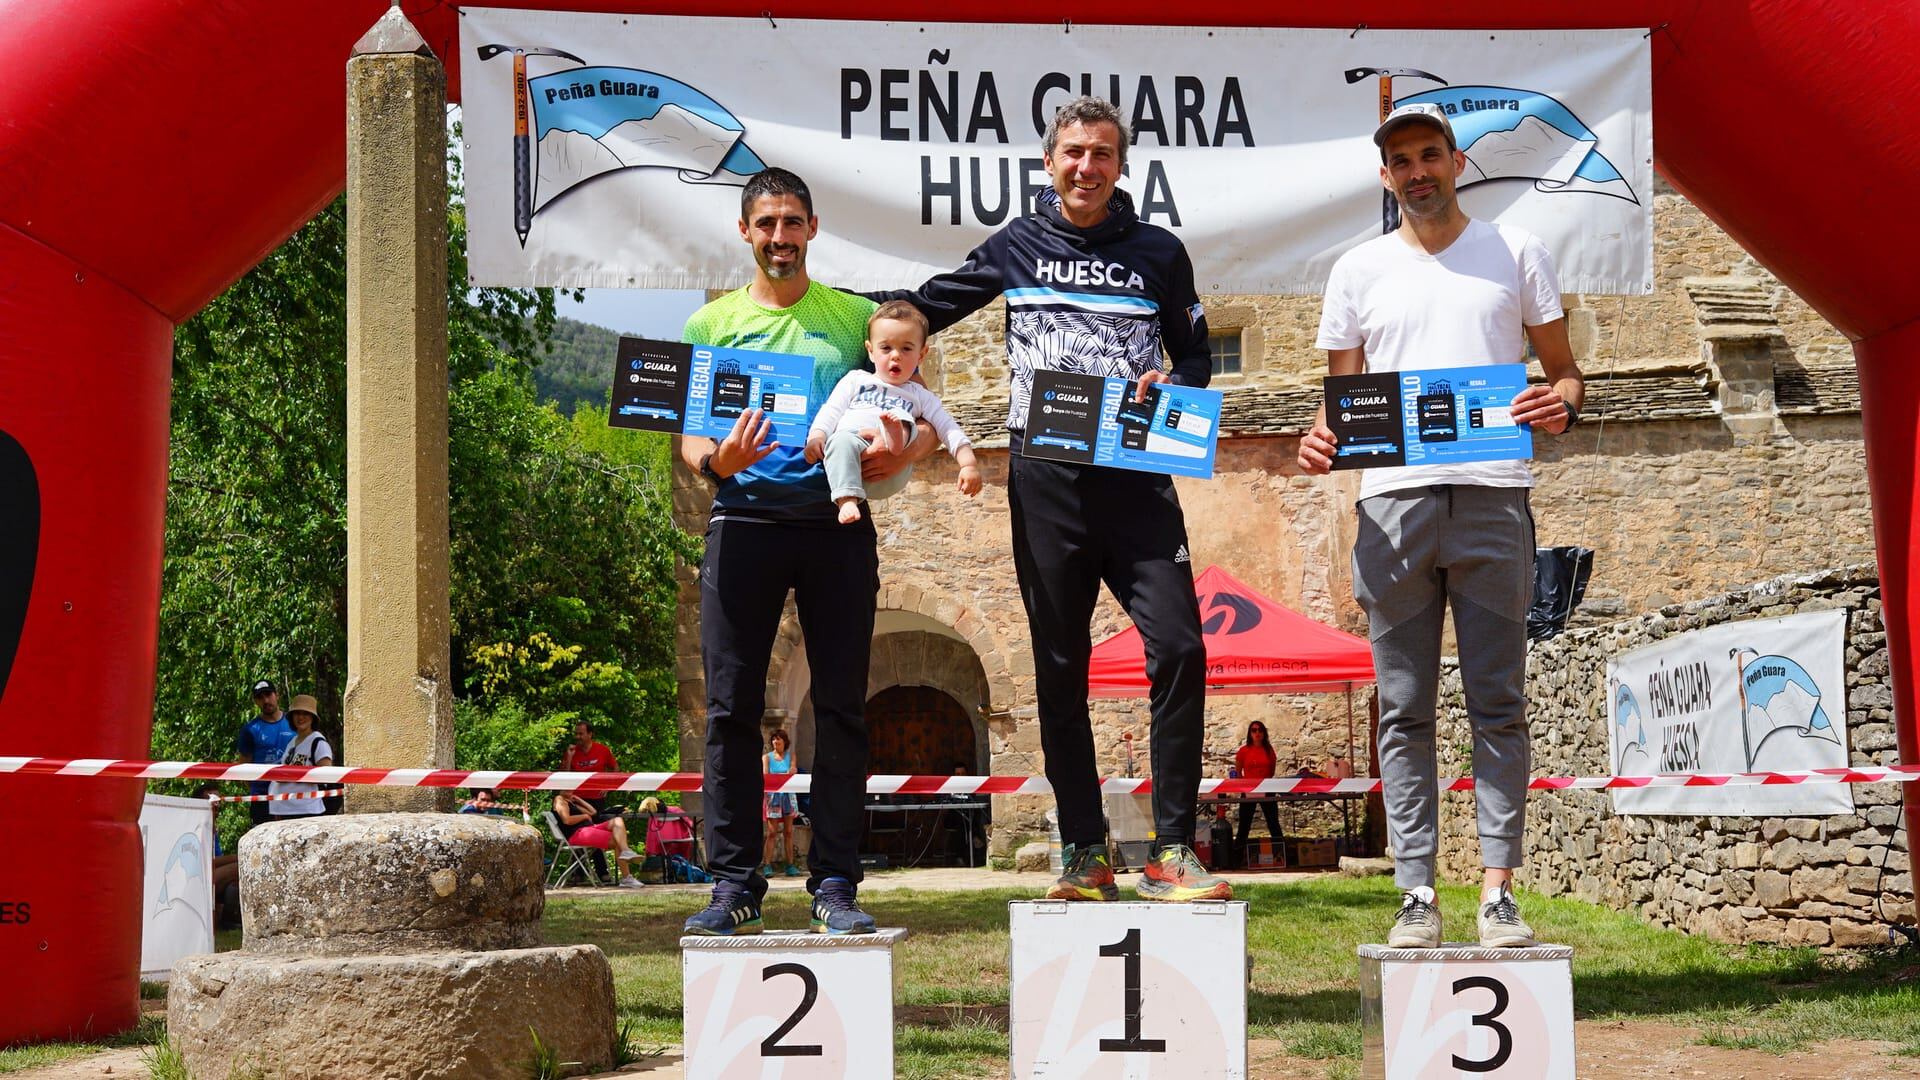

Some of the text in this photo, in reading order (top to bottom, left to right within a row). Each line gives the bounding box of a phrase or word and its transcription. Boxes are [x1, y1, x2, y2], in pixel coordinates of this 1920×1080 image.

[518, 72, 526, 121] 1932-2007
[544, 79, 660, 105] Peña Guara
[841, 48, 1009, 143] PEÑA
[1461, 98, 1519, 112] Guara
[920, 155, 1182, 228] HUEA
[1035, 258, 1145, 290] HUESCA
[643, 361, 677, 373] GUARA
[686, 350, 713, 431] VALE REGALO
[1056, 392, 1089, 404] GUARA
[1097, 382, 1124, 463] VALE REGALO
[1353, 396, 1388, 406] GUARA
[1403, 375, 1421, 427] REGALO
[1227, 660, 1248, 673] de
[1250, 659, 1310, 673] huesca
[1648, 658, 1676, 719] PEÑA
[1674, 660, 1711, 715] GUARA
[1761, 665, 1786, 677] Guara
[1660, 721, 1701, 772] HUESCA
[760, 962, 823, 1056] 2
[1099, 928, 1166, 1052] 1
[1451, 976, 1514, 1073] 3
